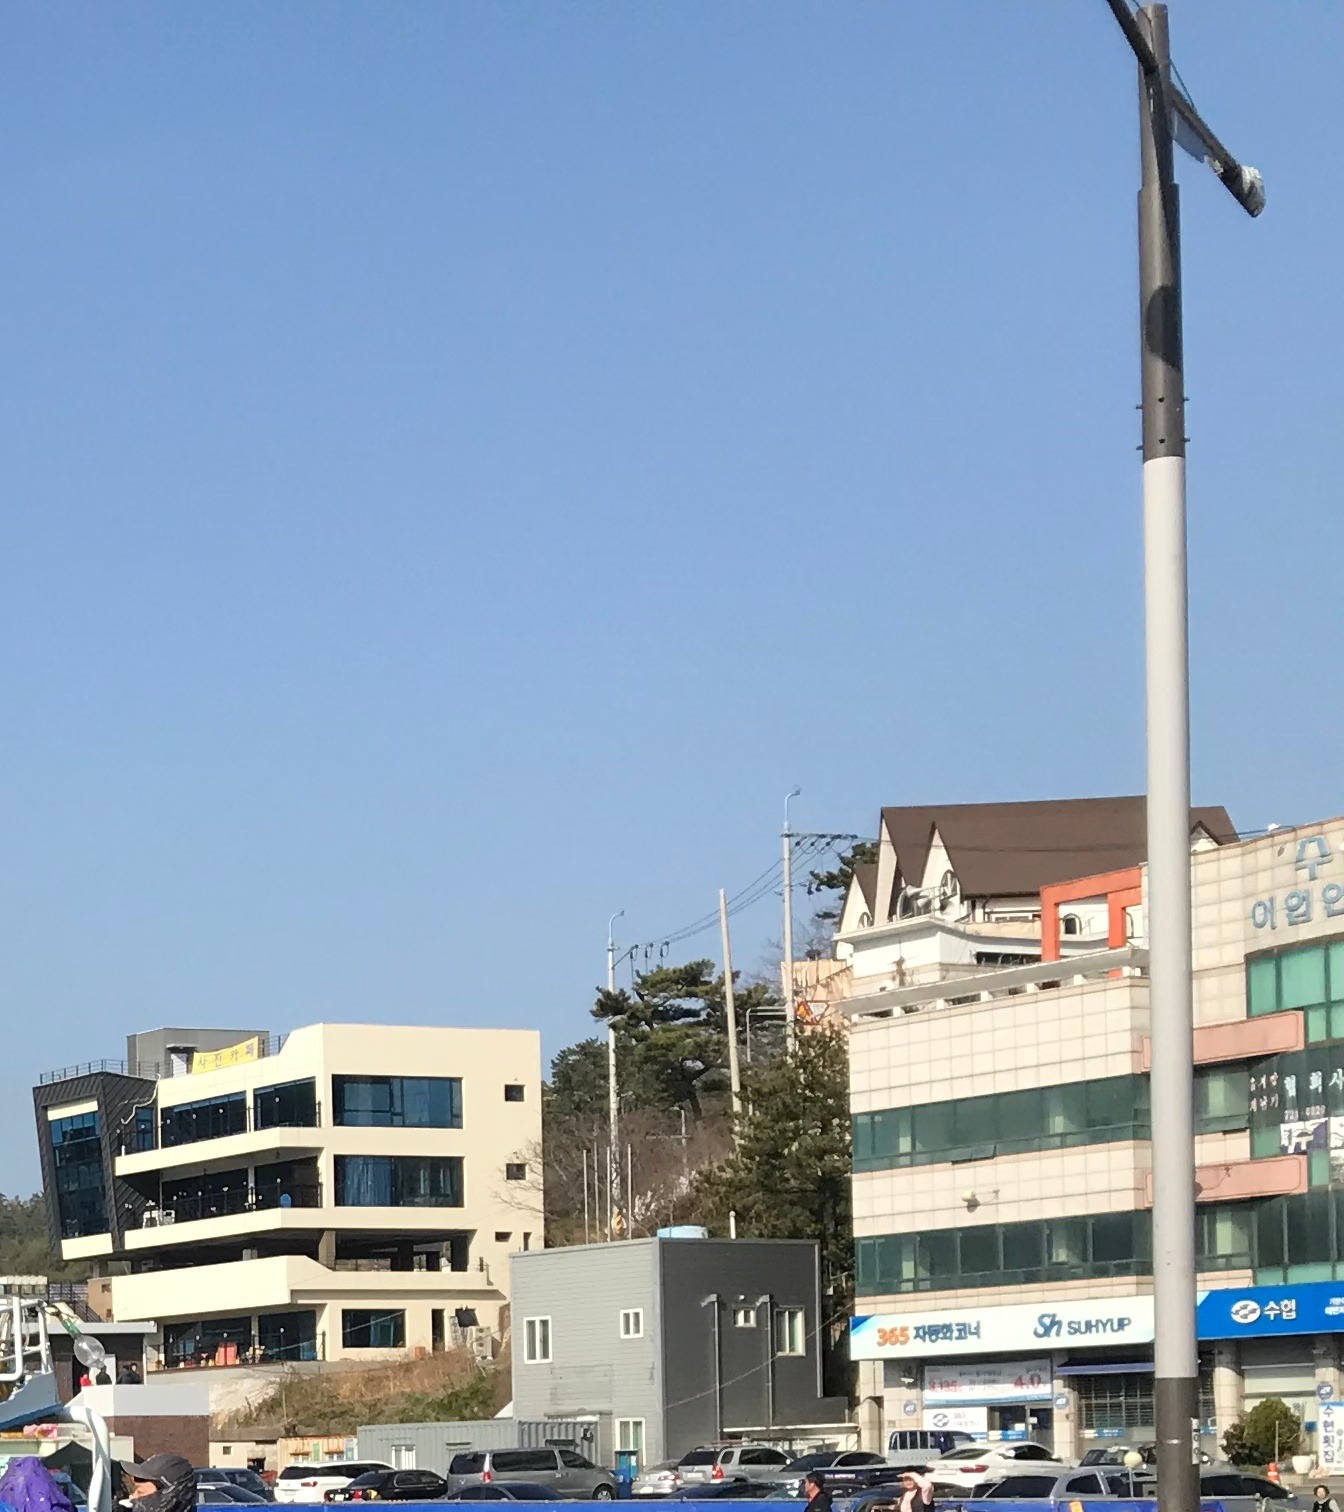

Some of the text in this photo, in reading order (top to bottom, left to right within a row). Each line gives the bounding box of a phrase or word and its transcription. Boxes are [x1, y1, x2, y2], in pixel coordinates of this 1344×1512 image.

[1263, 1299, 1297, 1320] 수협
[877, 1320, 981, 1346] 365 자동화코너
[1033, 1313, 1132, 1338] Sh SUHYUP
